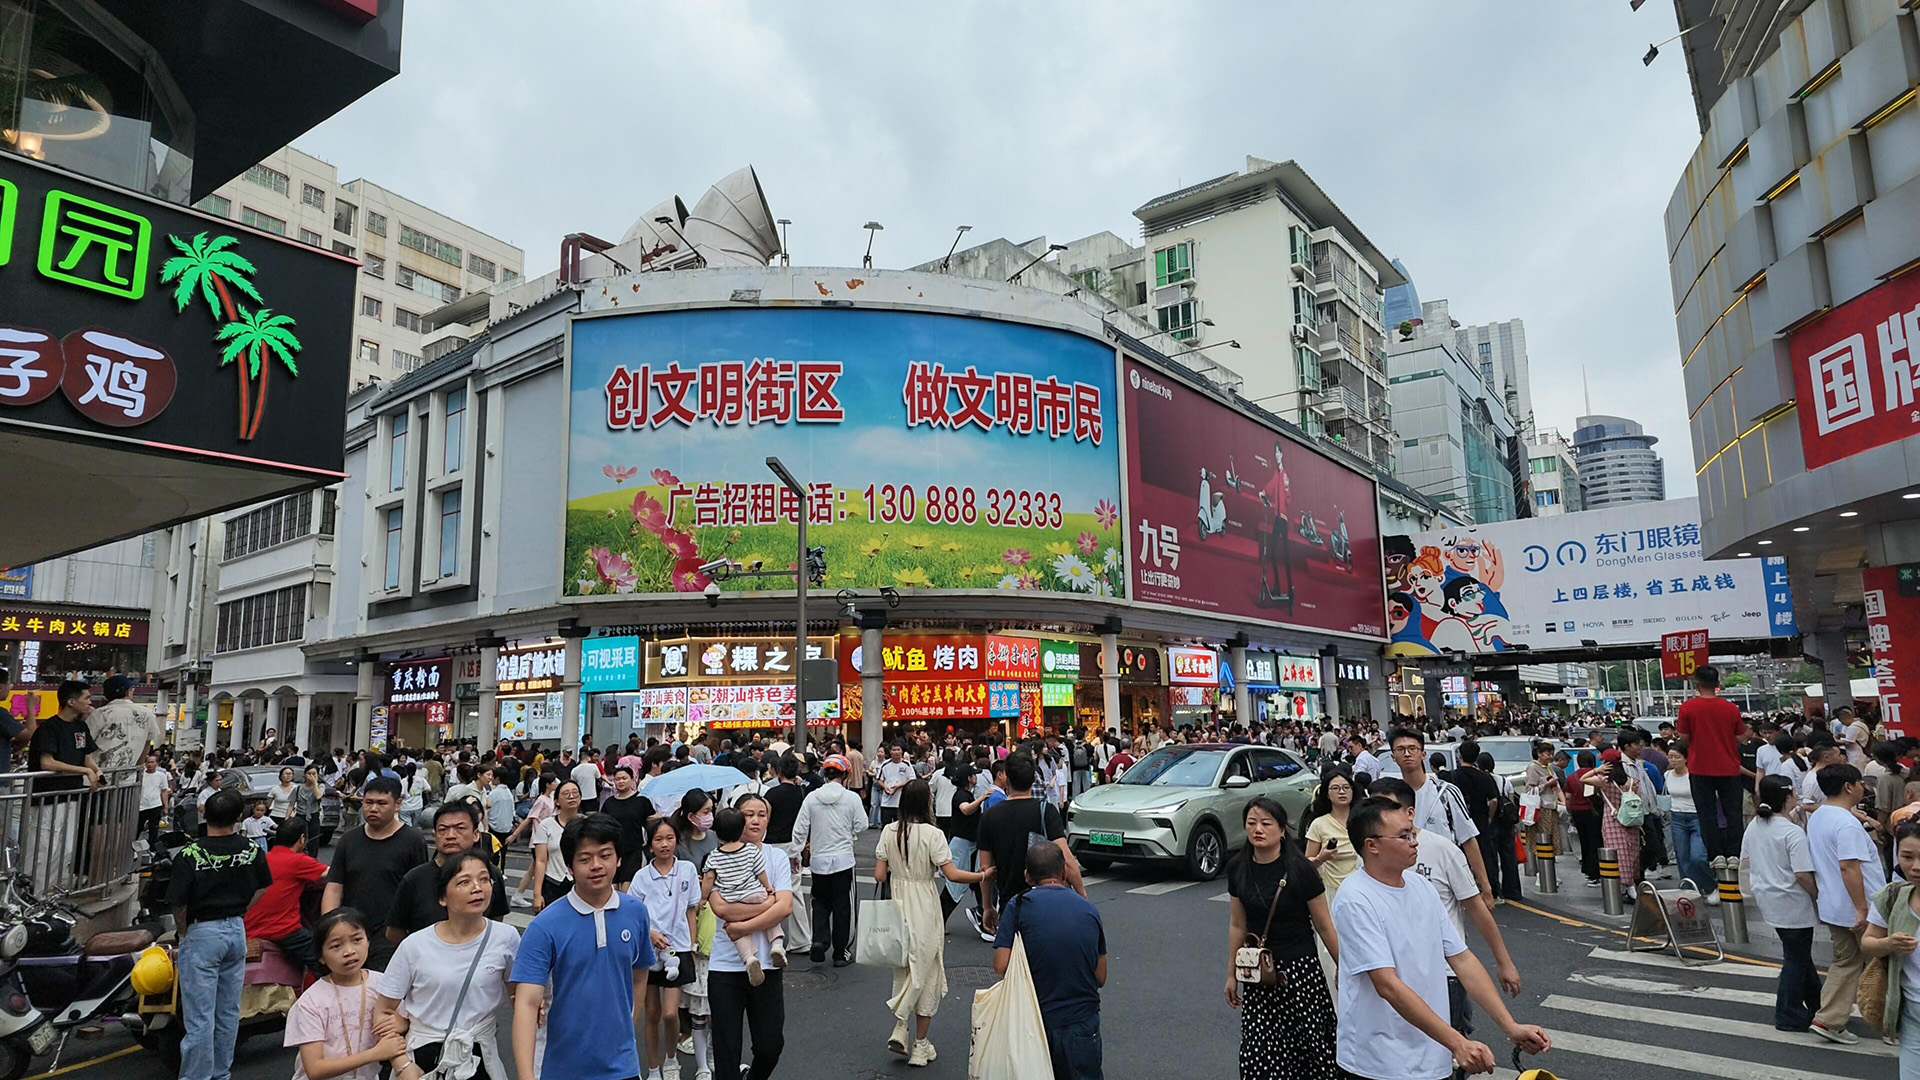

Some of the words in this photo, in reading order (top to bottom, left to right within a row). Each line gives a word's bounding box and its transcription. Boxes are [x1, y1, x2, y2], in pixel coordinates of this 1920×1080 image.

[0, 178, 152, 300] 园
[605, 358, 844, 429] 创文明街区
[904, 361, 1102, 445] 做文明市民
[863, 483, 915, 523] 130
[925, 486, 977, 525] 888
[986, 487, 1063, 530] 32333
[1139, 519, 1180, 571] 九号
[1594, 523, 1700, 555] 东门眼镜
[1596, 555, 1651, 568] DongMen
[1654, 549, 1703, 562] Glasses
[1, 616, 132, 638] 头牛肉火锅店
[496, 648, 565, 680] 分皇后糖水铺
[587, 646, 636, 669] 可视采耳
[933, 644, 979, 671] 烤肉
[392, 665, 440, 690] 重庆粉面
[641, 689, 686, 705] 潮汕美食
